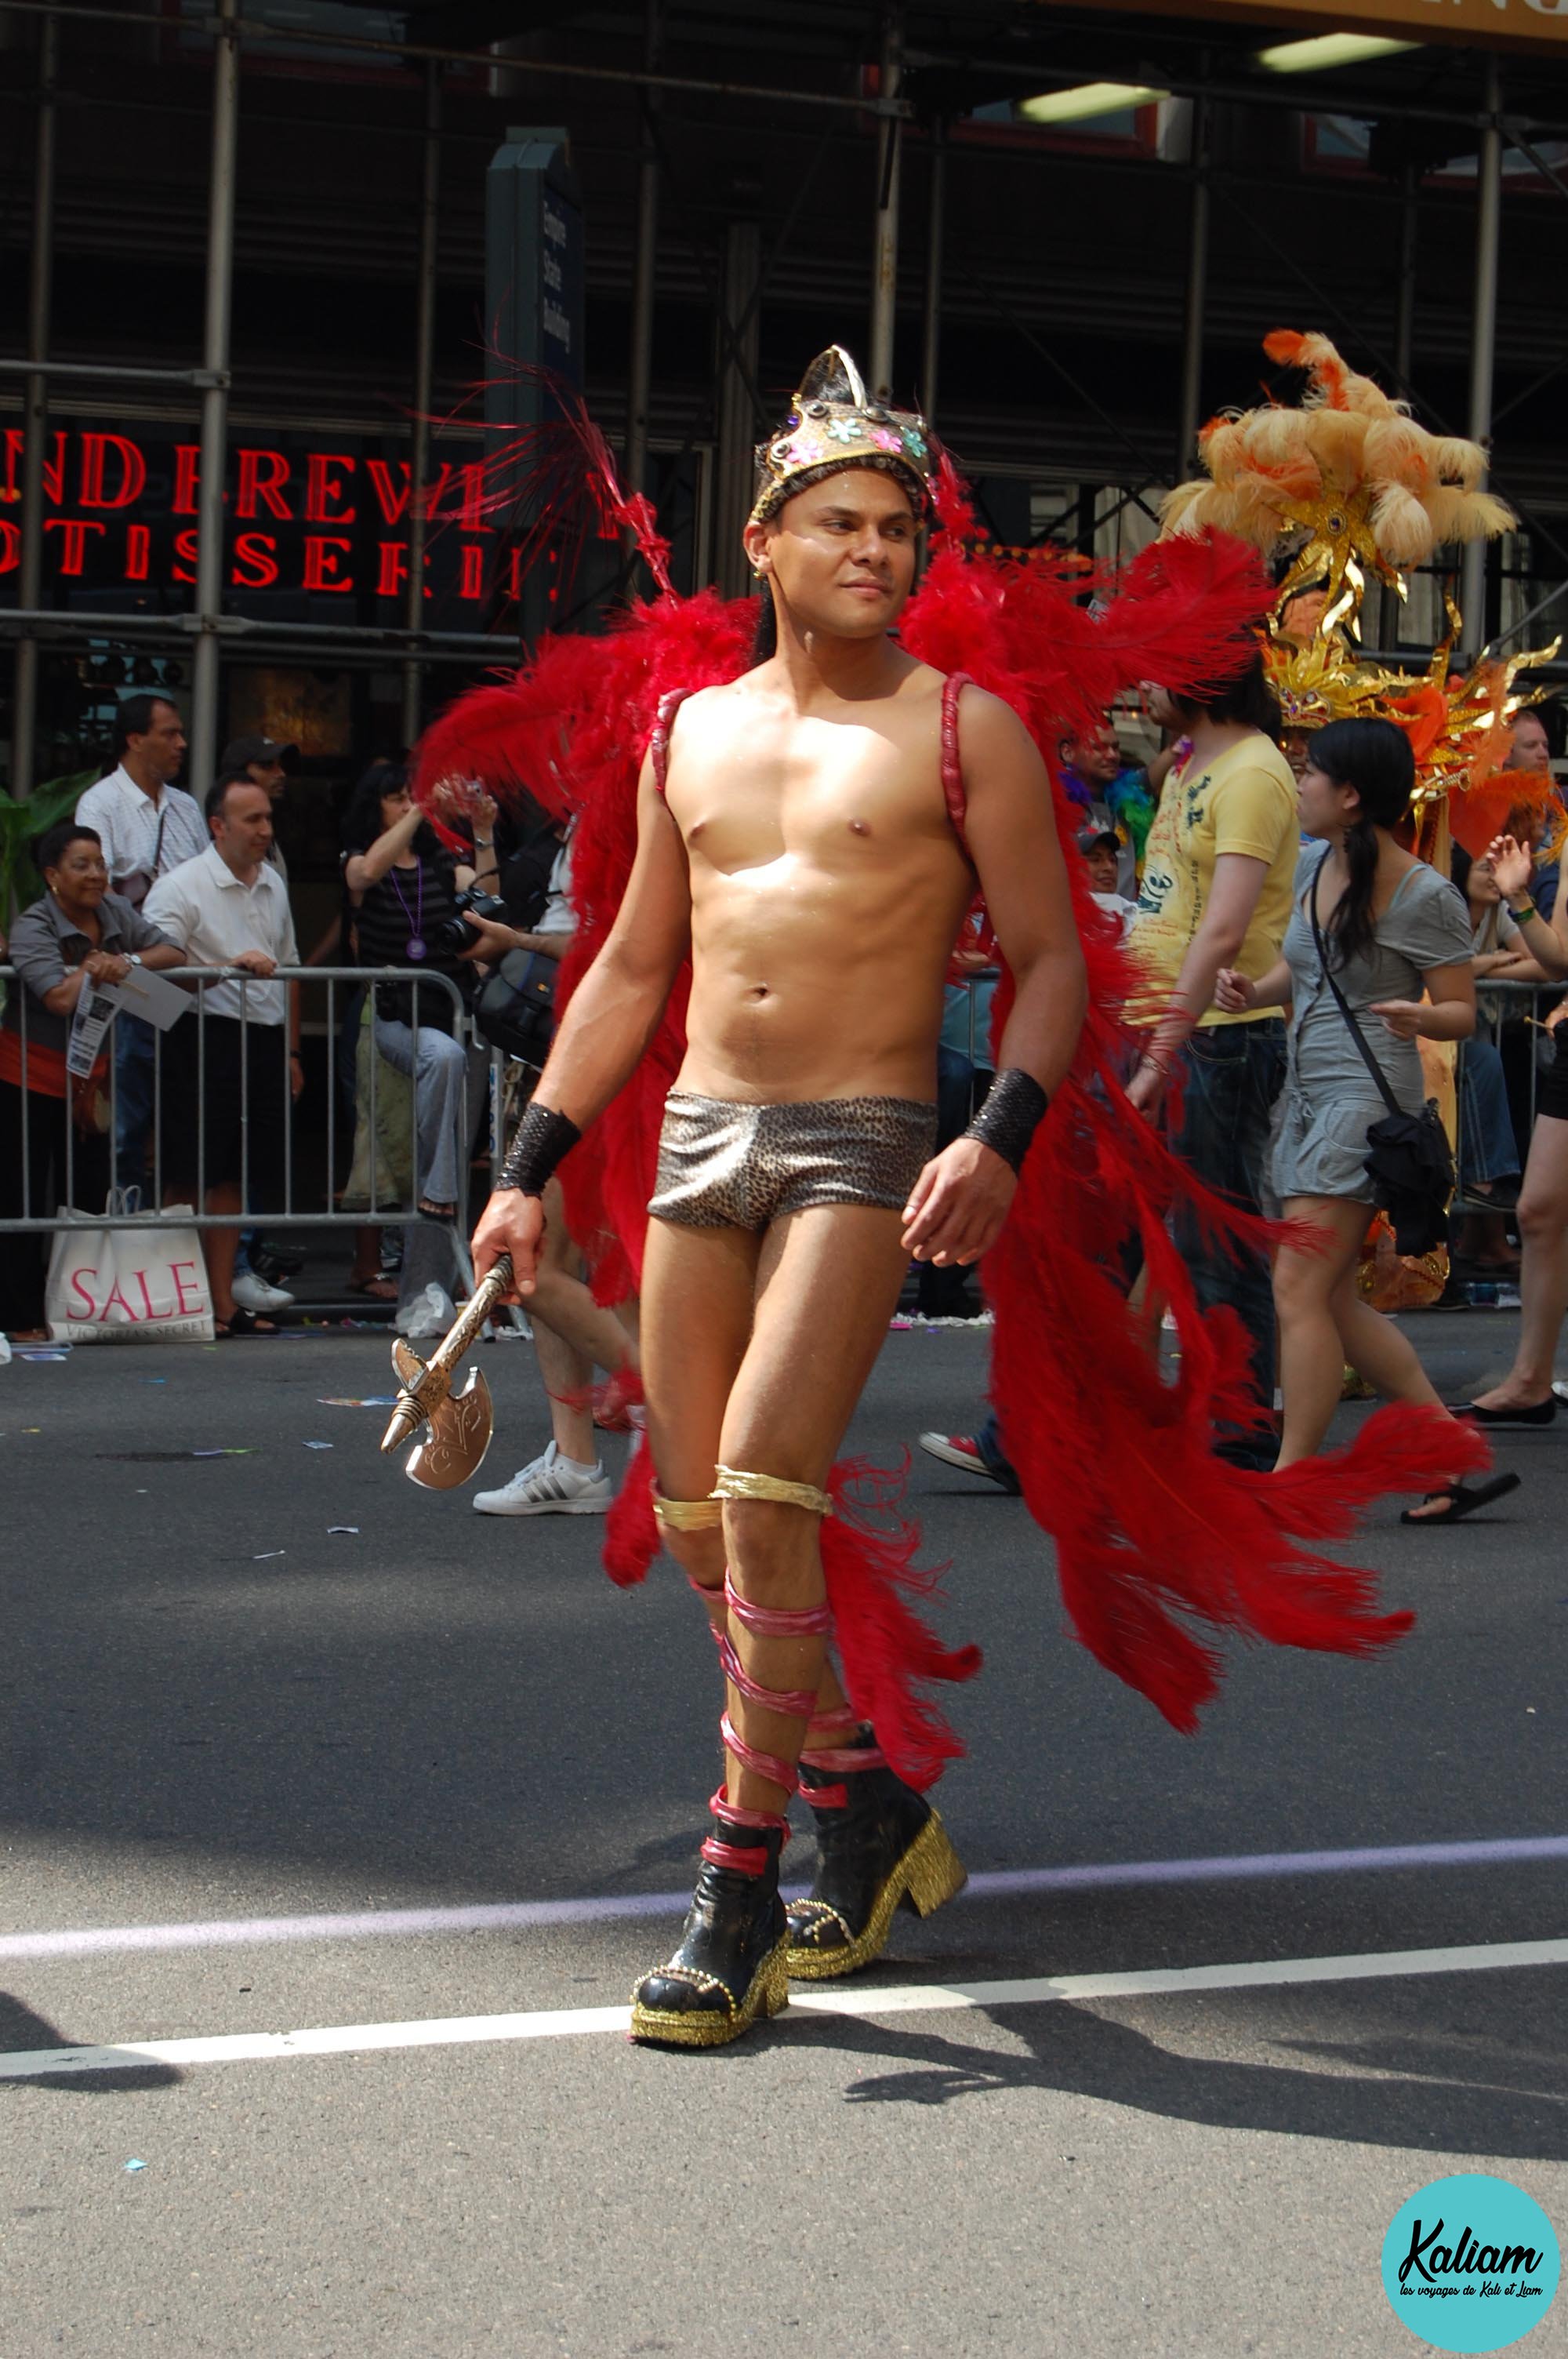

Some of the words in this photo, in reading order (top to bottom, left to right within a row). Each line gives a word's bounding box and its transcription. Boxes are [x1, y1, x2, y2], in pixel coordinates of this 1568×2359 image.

[172, 445, 621, 540] BREWY
[66, 1260, 205, 1322] SALE
[66, 1323, 151, 1339] VICTORIA'S
[156, 1320, 207, 1337] SECRET
